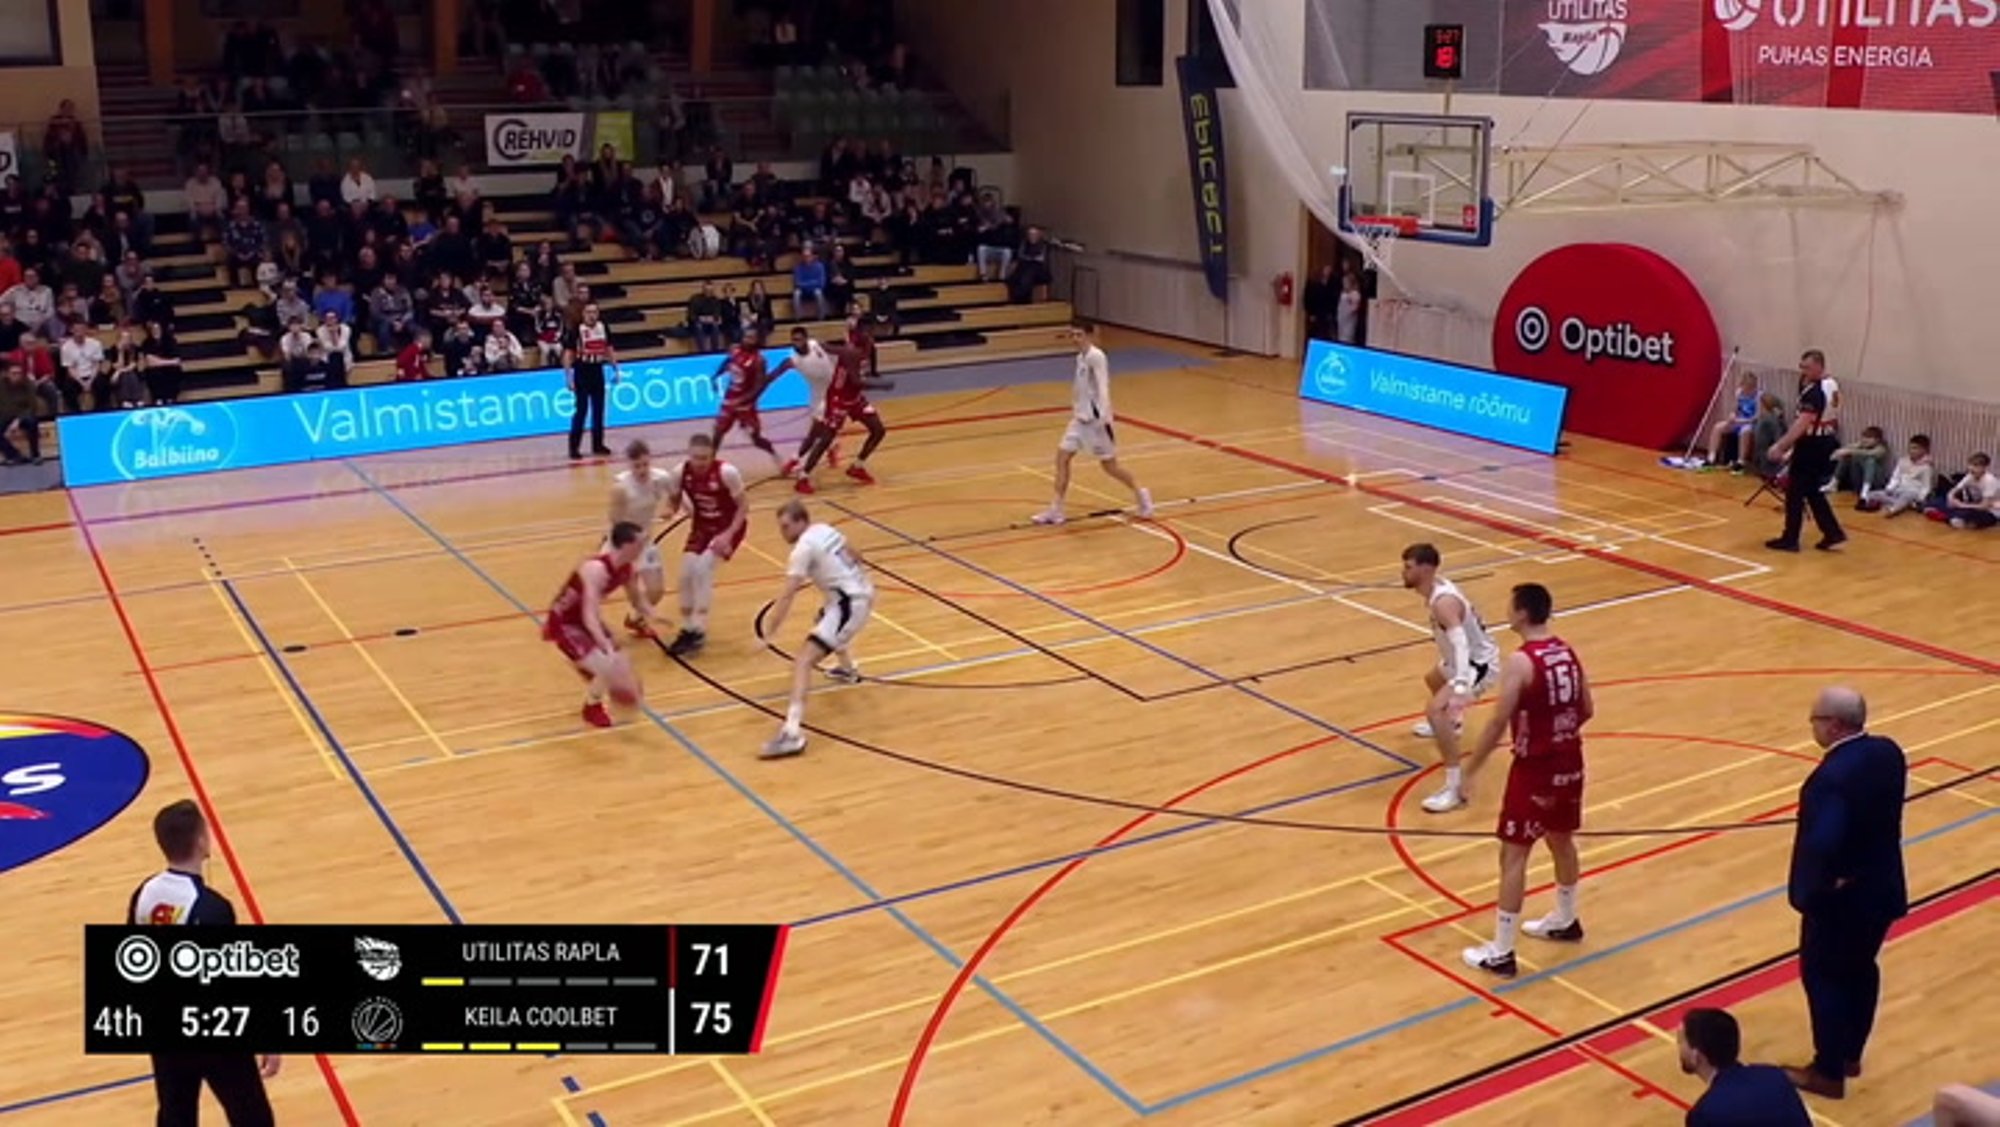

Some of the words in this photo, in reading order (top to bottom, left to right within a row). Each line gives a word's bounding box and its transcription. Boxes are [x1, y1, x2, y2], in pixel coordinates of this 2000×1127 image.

[1548, 0, 1628, 19] UTILITAS
[1758, 46, 1828, 66] PUHAS
[1834, 46, 1933, 67] ENERGIA
[1560, 317, 1674, 364] Optibet
[1370, 368, 1464, 410] Valmistame
[293, 386, 577, 444] Valmistame
[134, 445, 220, 469] Balbiino
